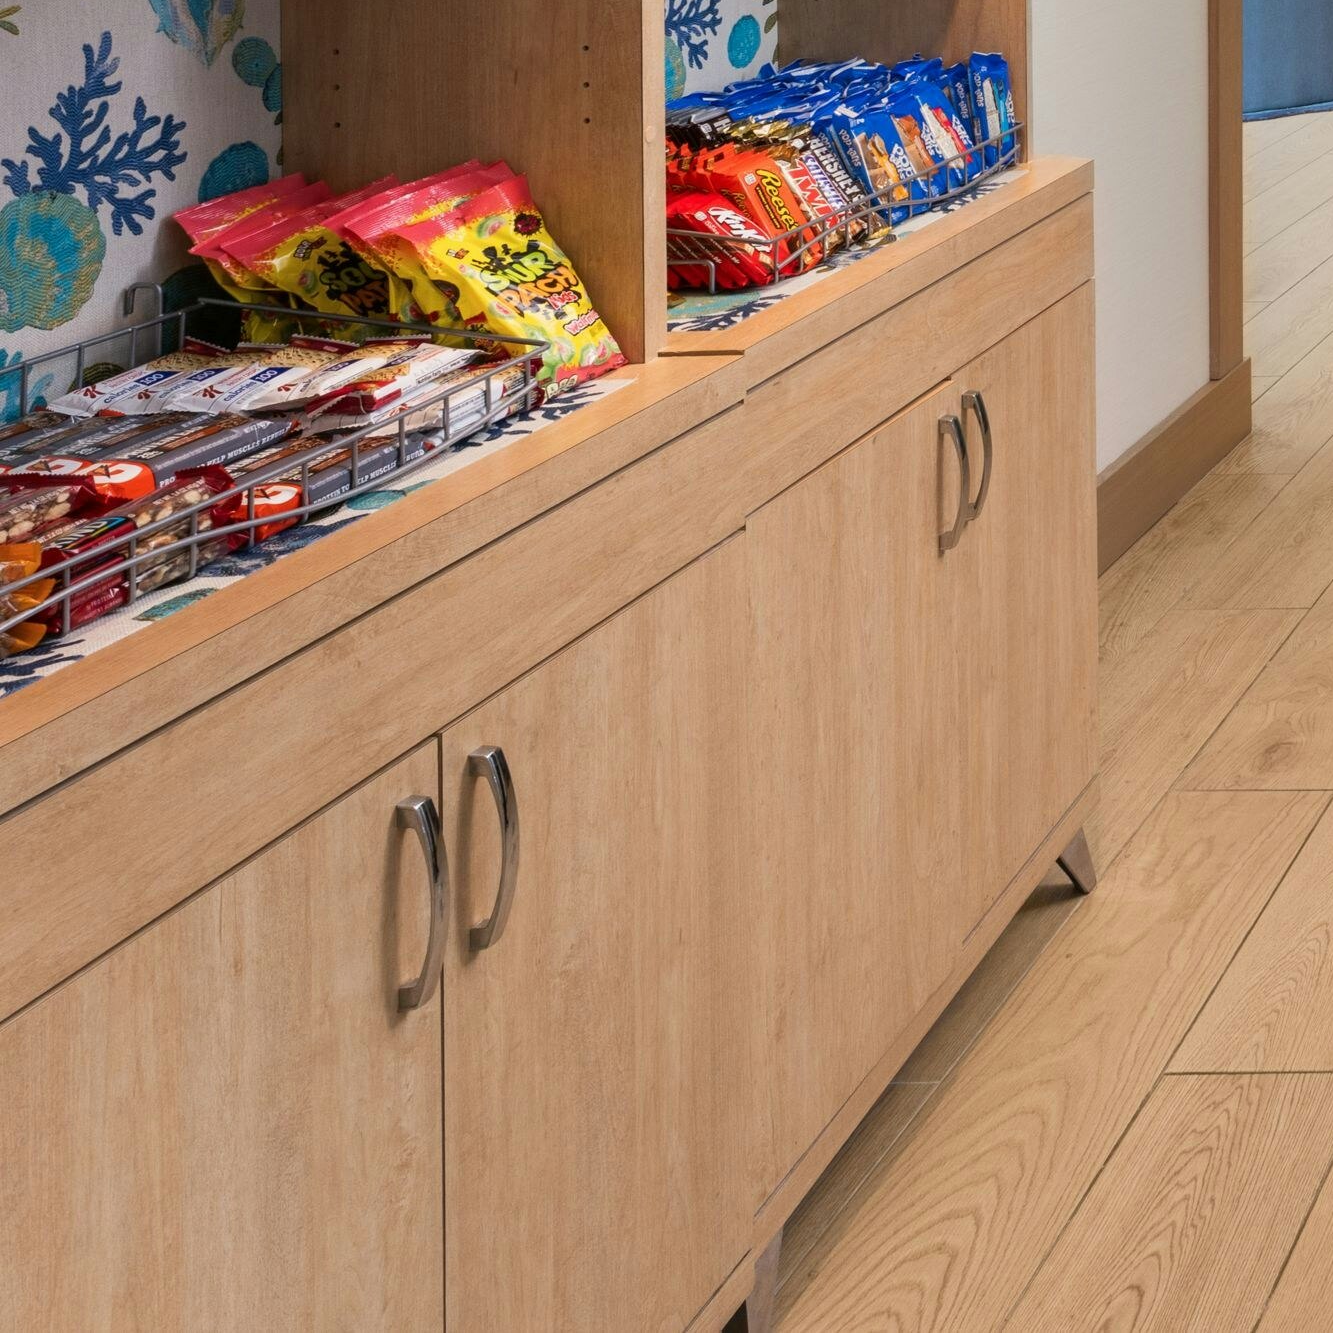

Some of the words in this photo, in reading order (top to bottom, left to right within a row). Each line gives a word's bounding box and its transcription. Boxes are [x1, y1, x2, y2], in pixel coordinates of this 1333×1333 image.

[498, 270, 579, 316] PATCH
[104, 382, 139, 404] calories
[140, 372, 164, 386] 100
[223, 381, 257, 402] calories
[257, 369, 279, 383] 100
